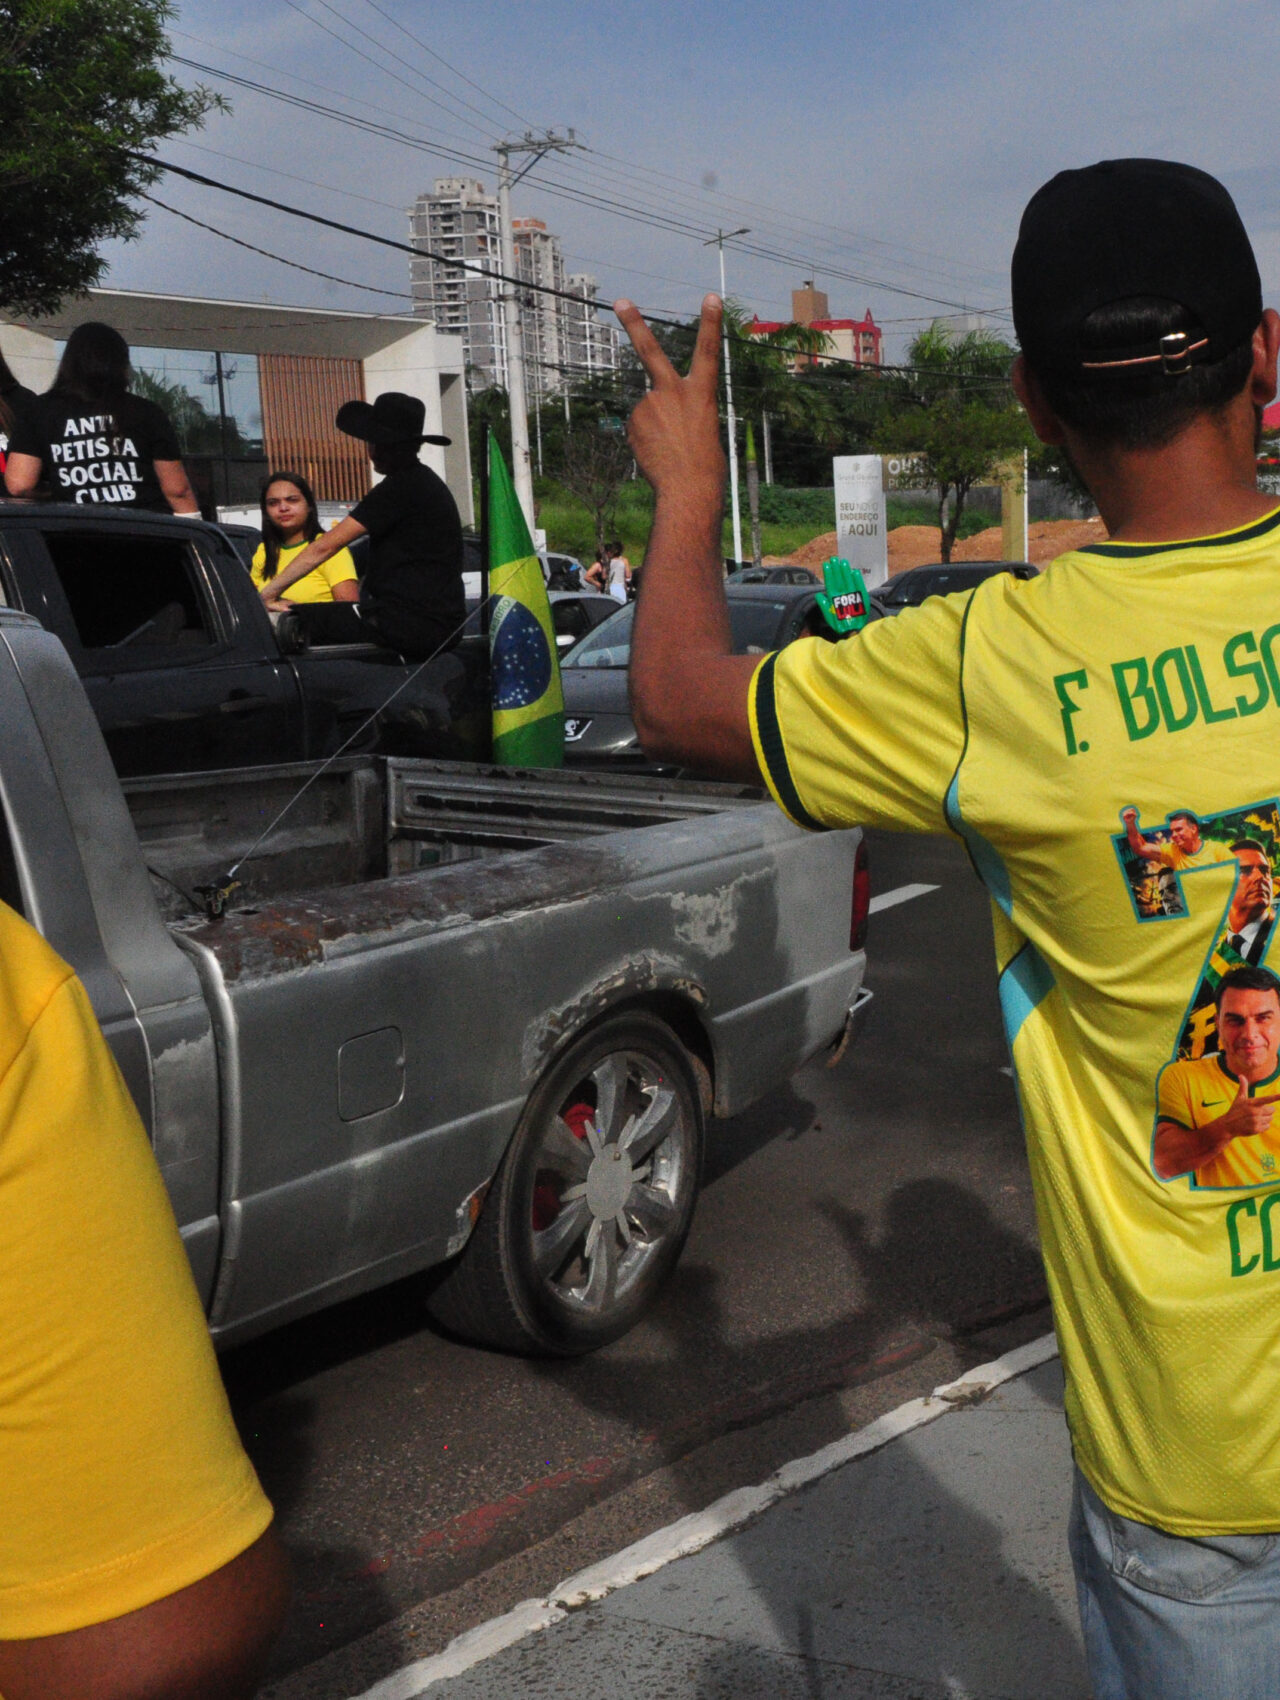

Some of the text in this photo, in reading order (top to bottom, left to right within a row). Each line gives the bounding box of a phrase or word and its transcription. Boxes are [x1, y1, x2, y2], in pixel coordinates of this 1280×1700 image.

[64, 415, 114, 437] ANT
[58, 461, 143, 487] SOCIAL
[75, 483, 137, 504] CLUB
[840, 502, 855, 511] SEU
[840, 512, 879, 522] ENDEREÇO
[848, 523, 878, 536] AQUI
[833, 592, 862, 609] FORA
[1053, 668, 1090, 756] F.
